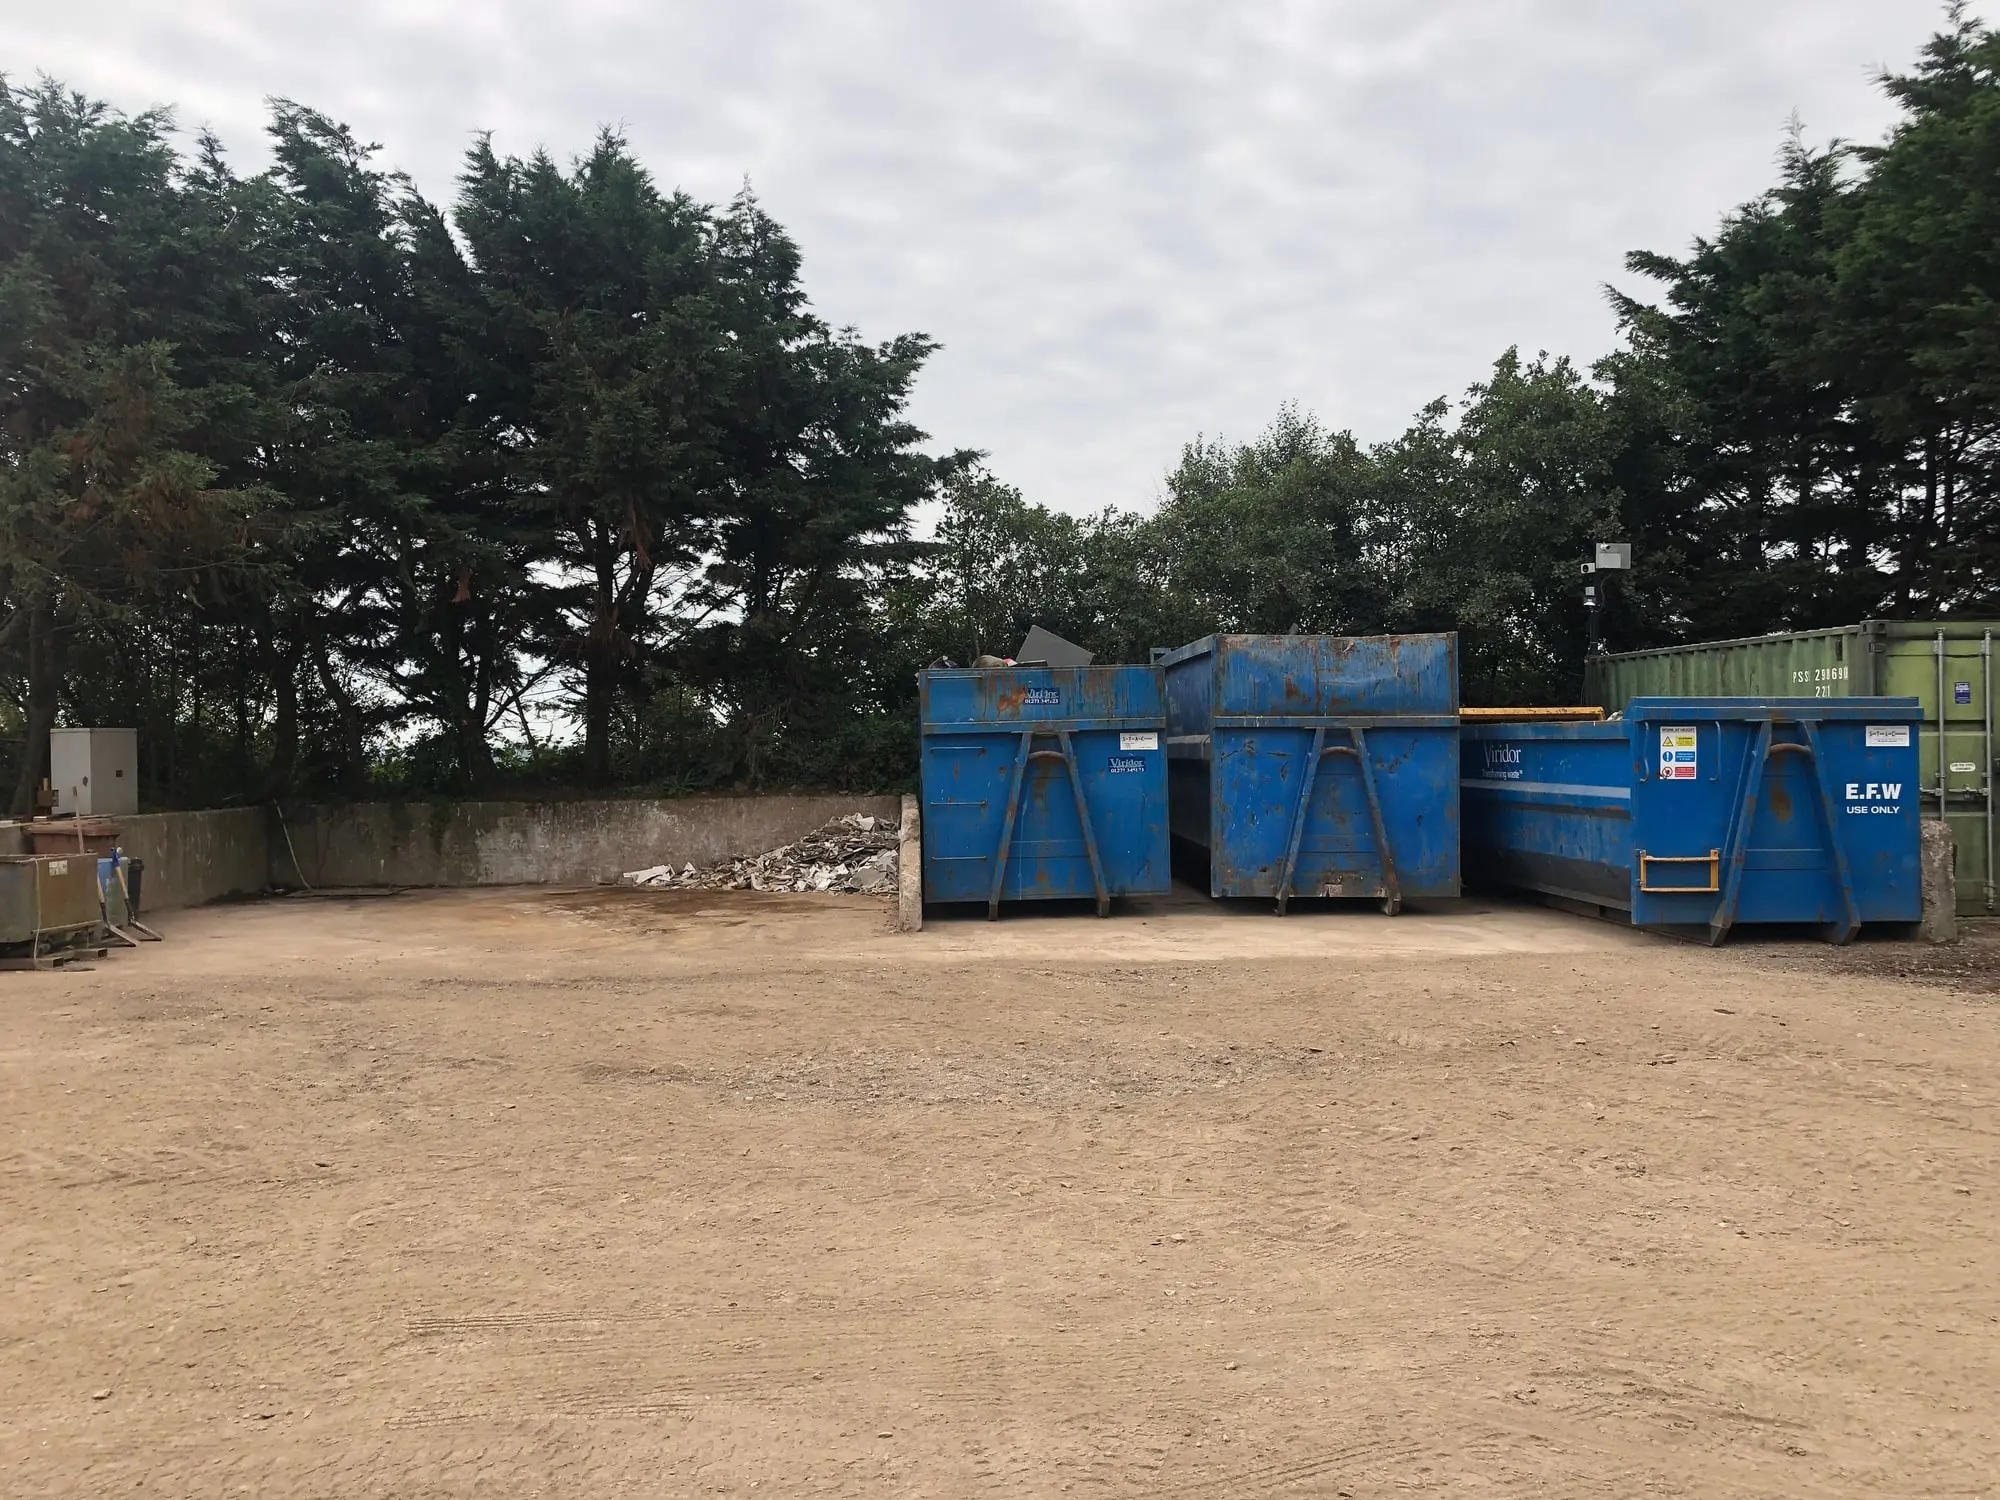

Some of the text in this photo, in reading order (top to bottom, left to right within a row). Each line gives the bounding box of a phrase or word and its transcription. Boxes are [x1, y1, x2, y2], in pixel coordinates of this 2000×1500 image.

[1483, 743, 1521, 768] Viridor
[1109, 758, 1145, 768] Viridor
[1846, 805, 1900, 814] USE ONLY
